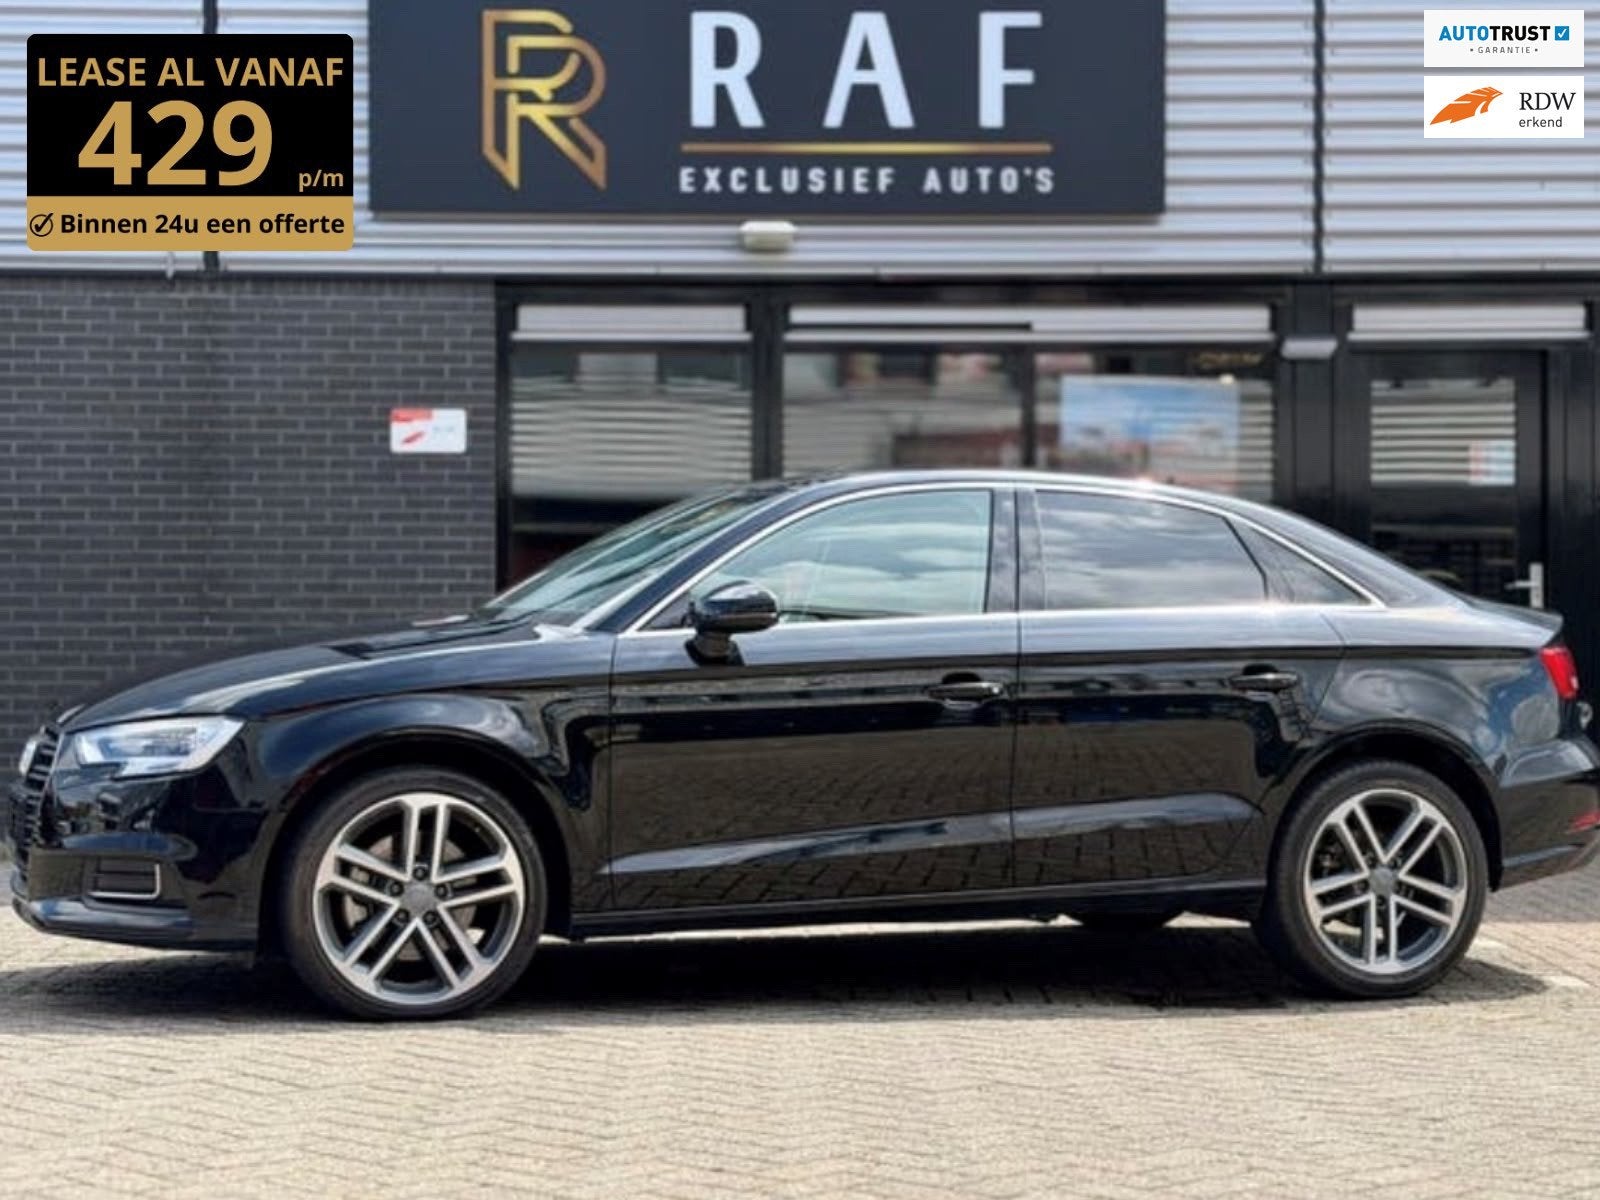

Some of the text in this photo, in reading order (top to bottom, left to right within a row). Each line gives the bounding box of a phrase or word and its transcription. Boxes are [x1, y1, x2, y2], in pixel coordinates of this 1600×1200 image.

[690, 11, 1043, 129] RAF
[679, 166, 1054, 194] EXCLUSIEF AUTO'S
